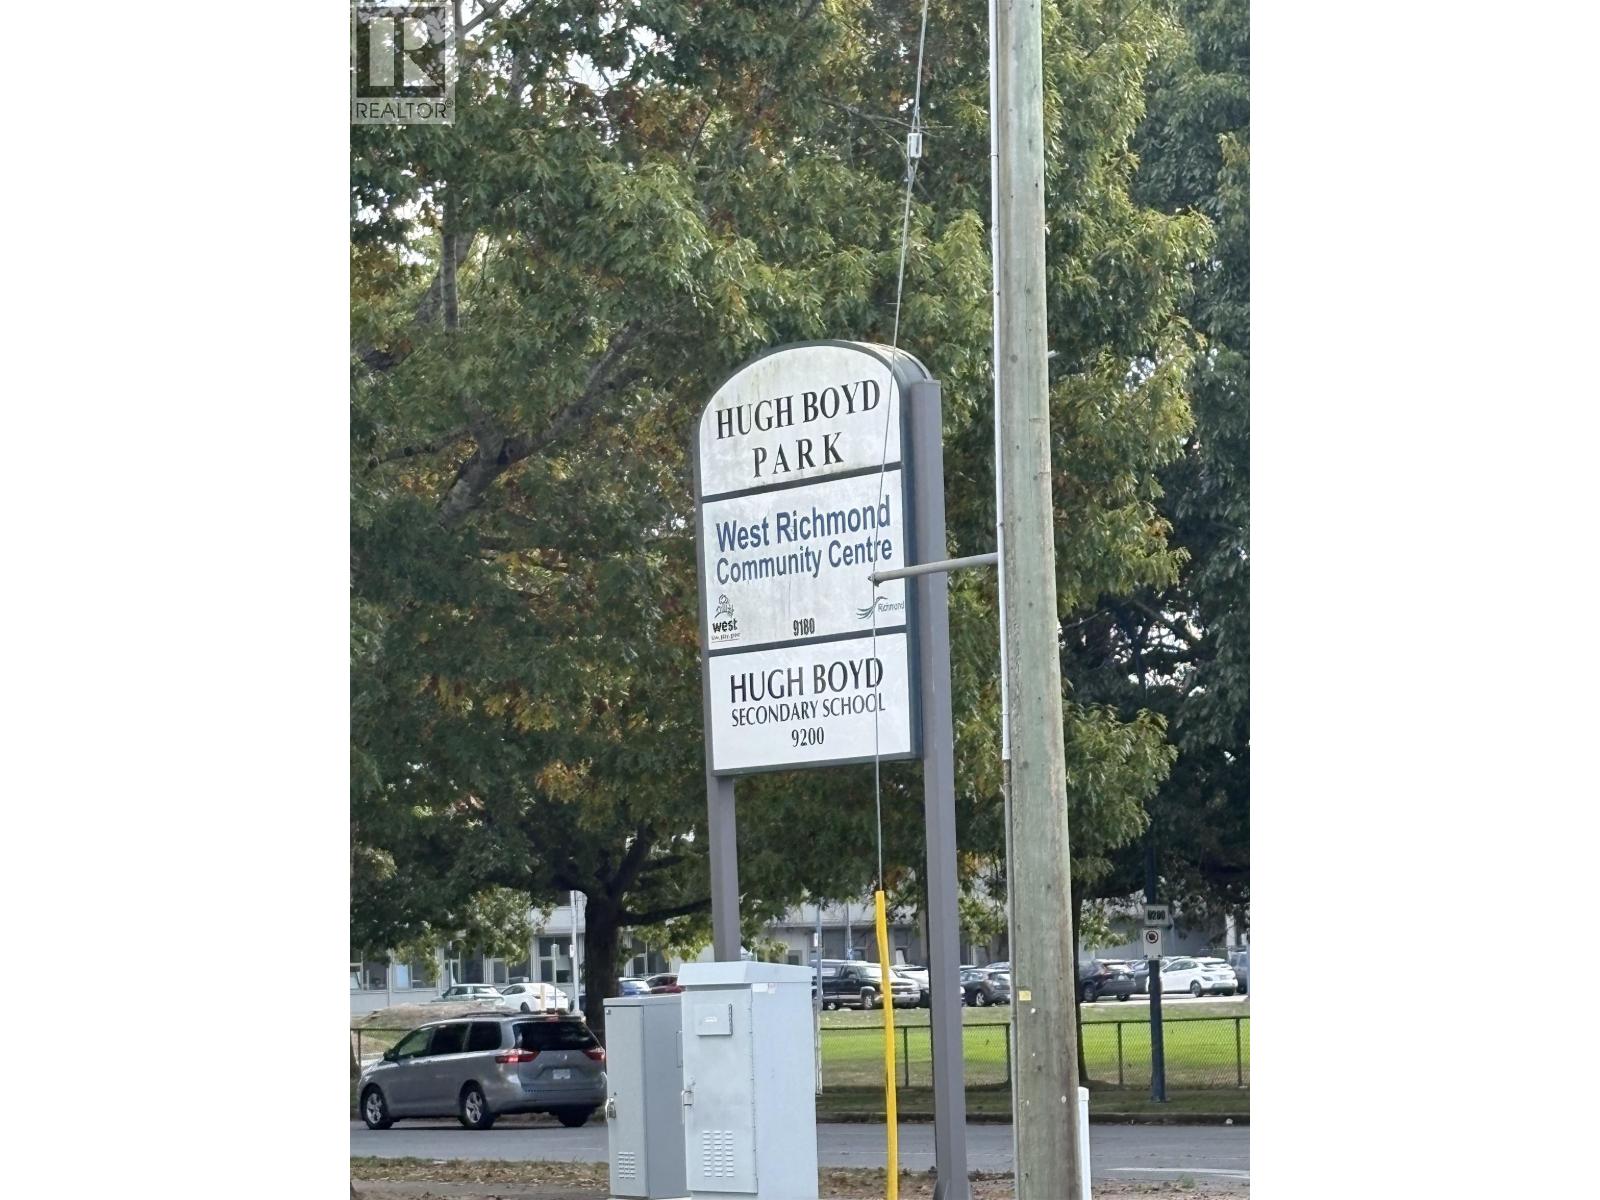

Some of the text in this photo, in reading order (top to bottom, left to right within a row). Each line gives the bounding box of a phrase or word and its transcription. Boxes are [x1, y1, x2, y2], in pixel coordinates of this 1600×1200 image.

[715, 379, 881, 440] HUGH BOYD
[752, 432, 844, 479] PARK
[716, 494, 891, 552] West Richmond
[716, 535, 893, 585] Community Centre
[712, 618, 738, 634] west
[792, 617, 816, 637] 9180
[730, 657, 884, 704] HUGH BOYD
[731, 692, 886, 727] SECONDARY SCHOOL
[791, 726, 825, 748] 9200
